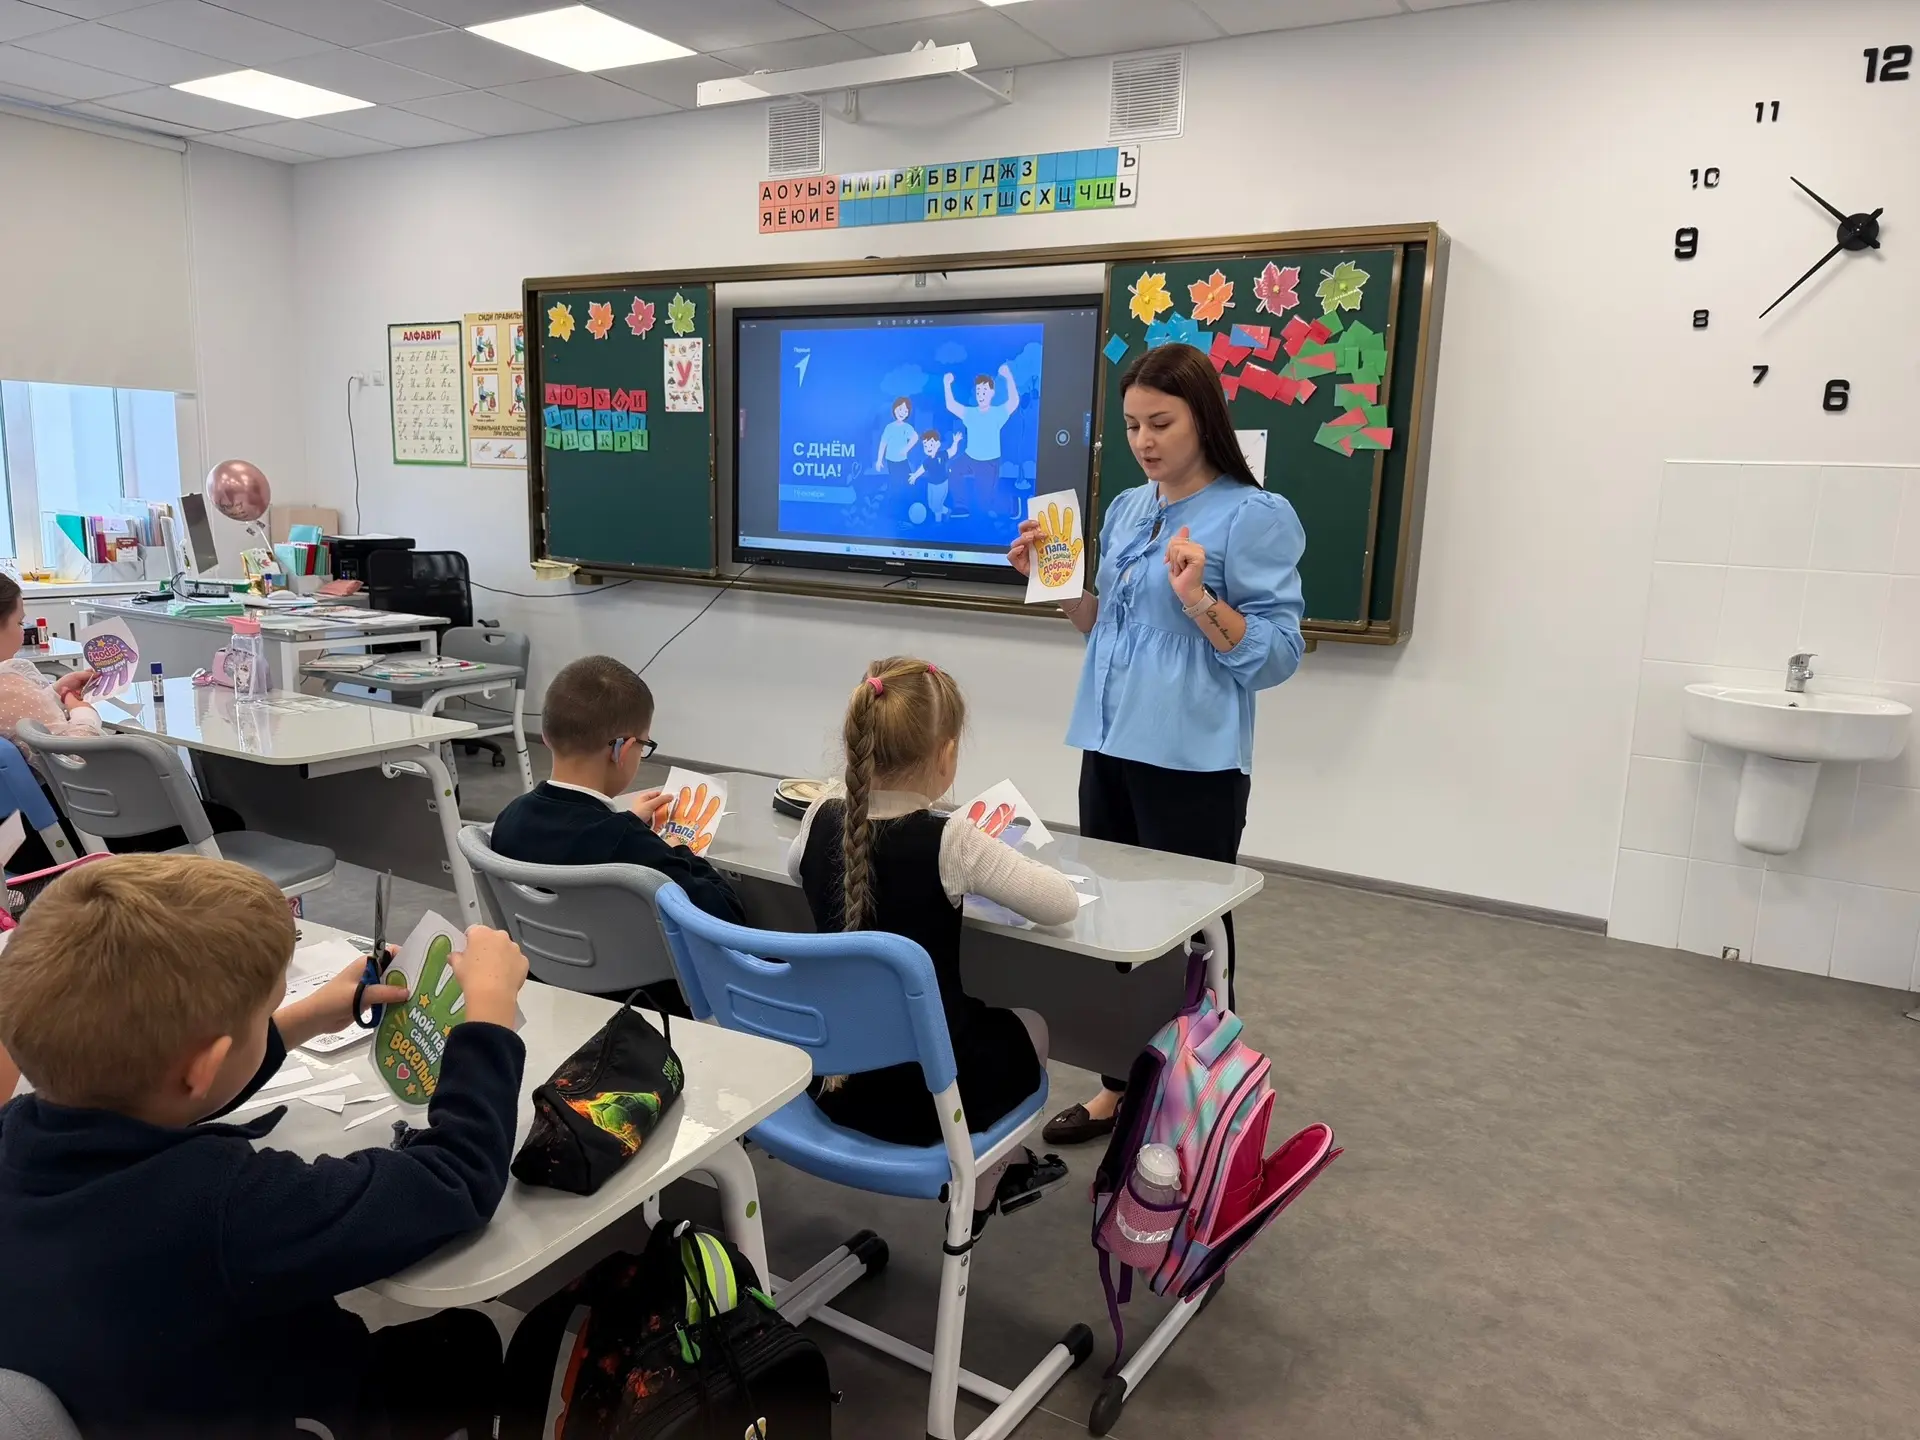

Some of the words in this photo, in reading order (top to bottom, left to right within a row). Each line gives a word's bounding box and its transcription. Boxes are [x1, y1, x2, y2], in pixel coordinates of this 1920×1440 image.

[1863, 44, 1913, 83] 12
[1754, 100, 1781, 123] 11
[762, 186, 772, 201] А
[777, 185, 788, 199] О
[794, 183, 803, 198] У
[808, 182, 821, 197] Ы
[826, 180, 836, 195] Э
[842, 179, 852, 193] Н
[858, 178, 870, 192] М
[876, 175, 886, 190] Л
[894, 173, 904, 188] Р
[928, 170, 939, 186] Б
[946, 168, 957, 184] В
[965, 166, 975, 182] Г
[982, 164, 995, 184] Д
[1000, 163, 1016, 179] Ж
[1022, 160, 1032, 177] З
[1120, 151, 1136, 168] Ъ
[1689, 167, 1720, 190] 10
[762, 212, 772, 226] Я
[778, 207, 787, 225] Ё
[791, 209, 805, 224] Ю
[809, 208, 819, 222] И
[826, 206, 835, 221] Е
[927, 198, 938, 214] П
[944, 197, 957, 212] Ф
[964, 195, 974, 211] К
[982, 193, 993, 209] Т
[998, 191, 1014, 208] Ш
[1019, 190, 1031, 206] С
[1039, 188, 1051, 205] Х
[1059, 186, 1071, 205] Ц
[1080, 184, 1091, 201] Ч
[1096, 182, 1114, 202] Щ
[1119, 182, 1132, 198] Ь
[1674, 226, 1699, 260] 9
[1692, 309, 1710, 328] 8
[403, 330, 442, 342] АЛФАВИТ
[676, 359, 693, 388] У
[1752, 364, 1769, 385] 7
[1822, 379, 1850, 412] 6
[792, 442, 805, 456] С
[806, 440, 856, 458] ДНЁМ
[792, 462, 842, 480] ОТЦА!
[1045, 543, 1070, 556] Папа,
[410, 1028, 439, 1065] самый
[430, 1031, 445, 1056] па
